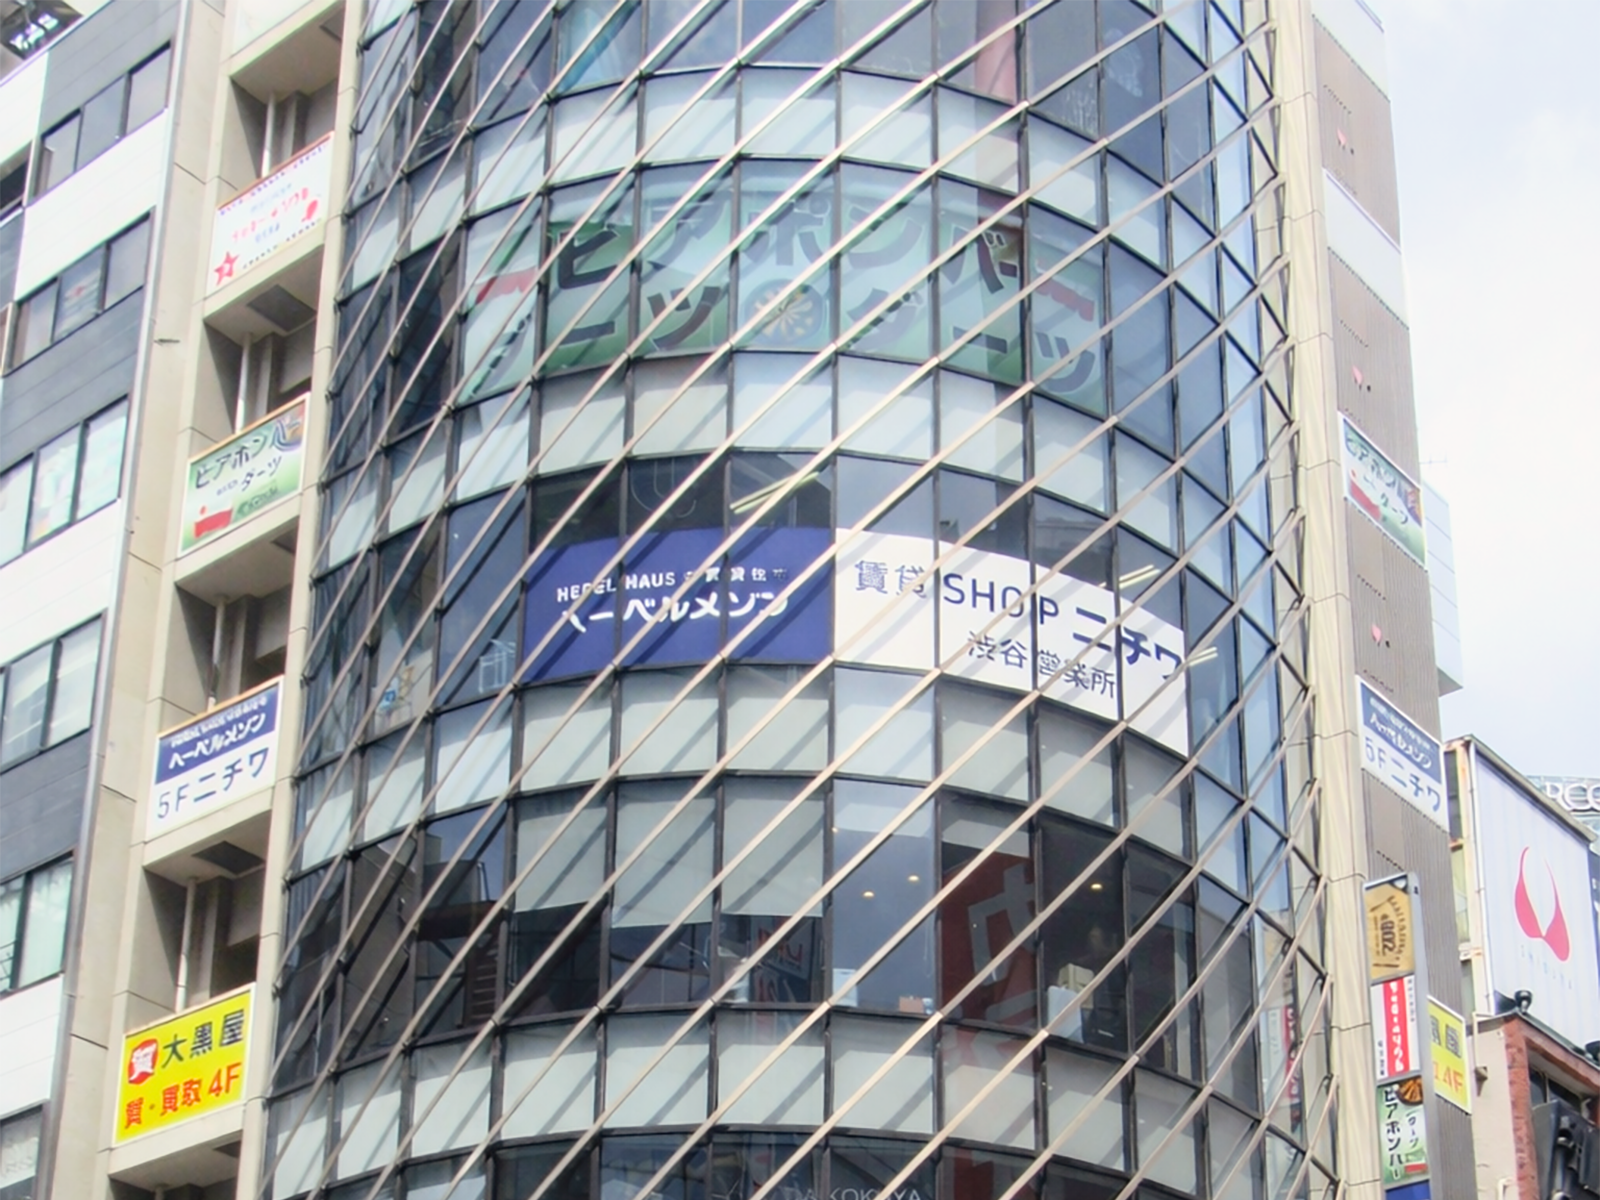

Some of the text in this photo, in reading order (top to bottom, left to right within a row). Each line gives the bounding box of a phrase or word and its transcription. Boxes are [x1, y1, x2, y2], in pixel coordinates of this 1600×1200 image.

[625, 571, 676, 590] HAUS
[943, 572, 1059, 625] SHOP
[967, 630, 1116, 699] 渋谷営業所
[161, 1008, 245, 1069] 大黒屋
